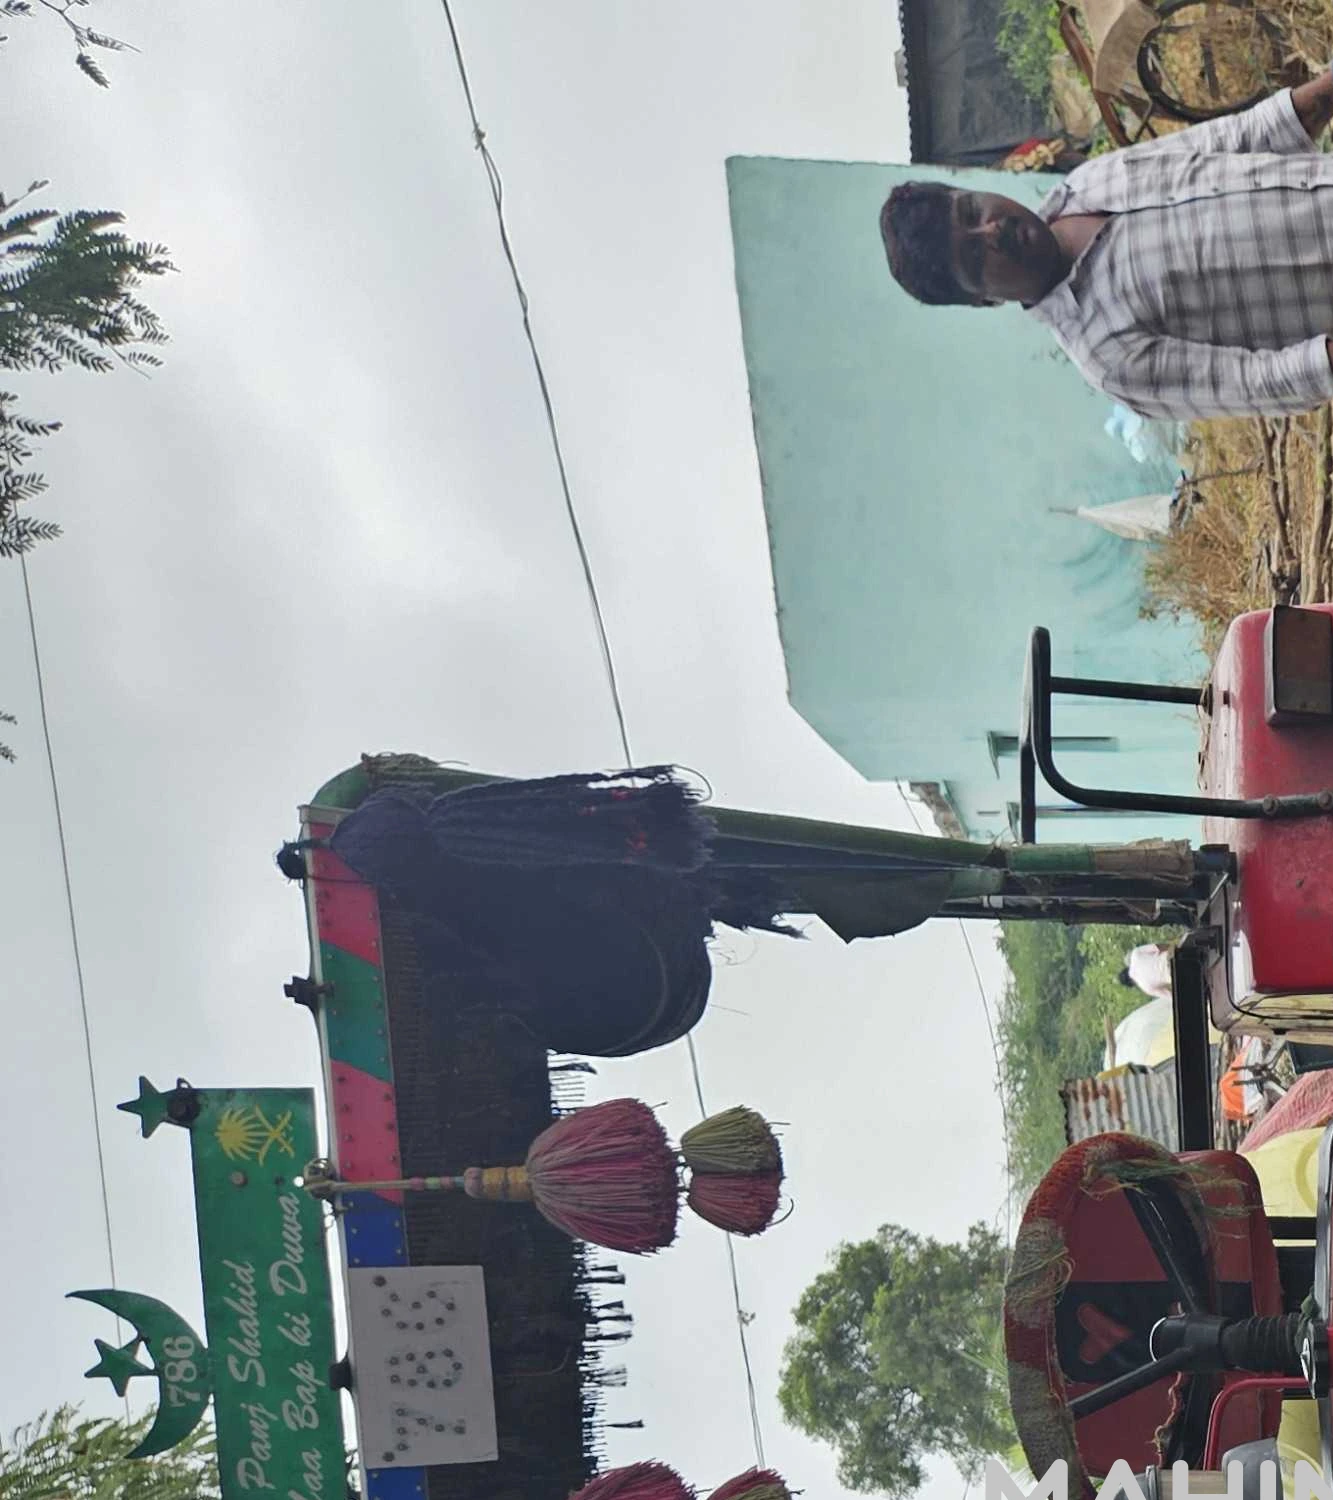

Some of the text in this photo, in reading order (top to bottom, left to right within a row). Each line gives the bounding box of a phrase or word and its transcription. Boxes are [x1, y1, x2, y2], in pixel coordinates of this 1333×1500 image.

[270, 1190, 309, 1296] Duwa
[279, 1311, 312, 1345] ki
[162, 1334, 200, 1406] 786
[223, 1258, 278, 1489] Panj Shahid
[284, 1358, 327, 1431] Bap
